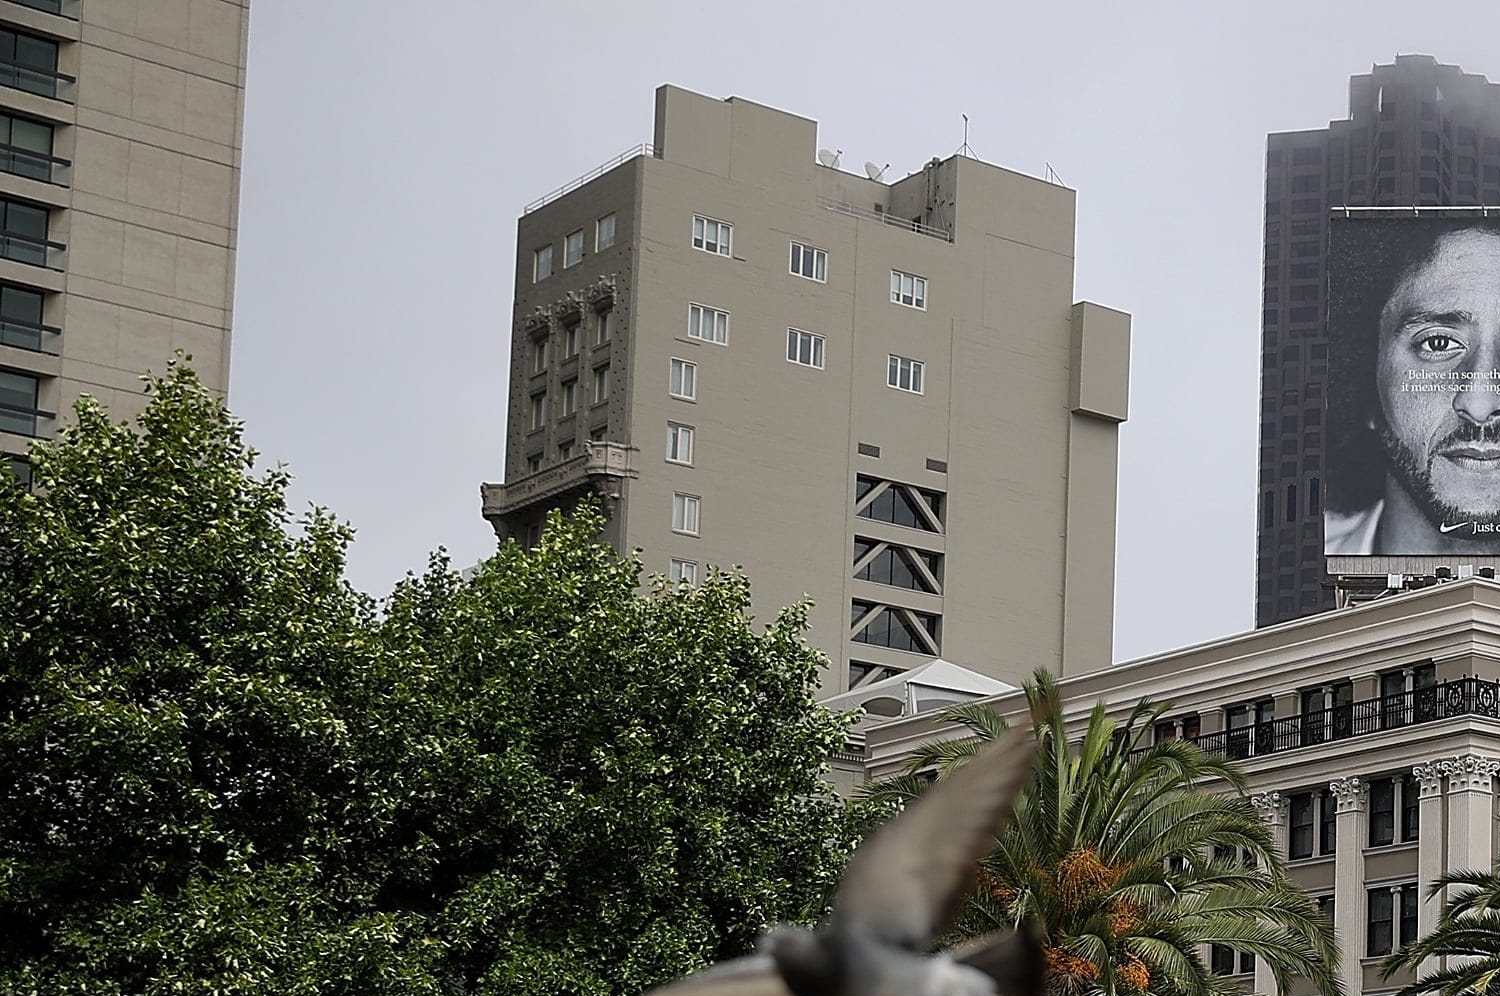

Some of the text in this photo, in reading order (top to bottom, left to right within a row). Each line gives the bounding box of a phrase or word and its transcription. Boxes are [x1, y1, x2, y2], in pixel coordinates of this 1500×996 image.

[1408, 369, 1447, 380] Believe
[1449, 369, 1460, 380] in
[1401, 382, 1410, 392] it
[1410, 383, 1446, 392] means
[1472, 522, 1494, 534] Just
